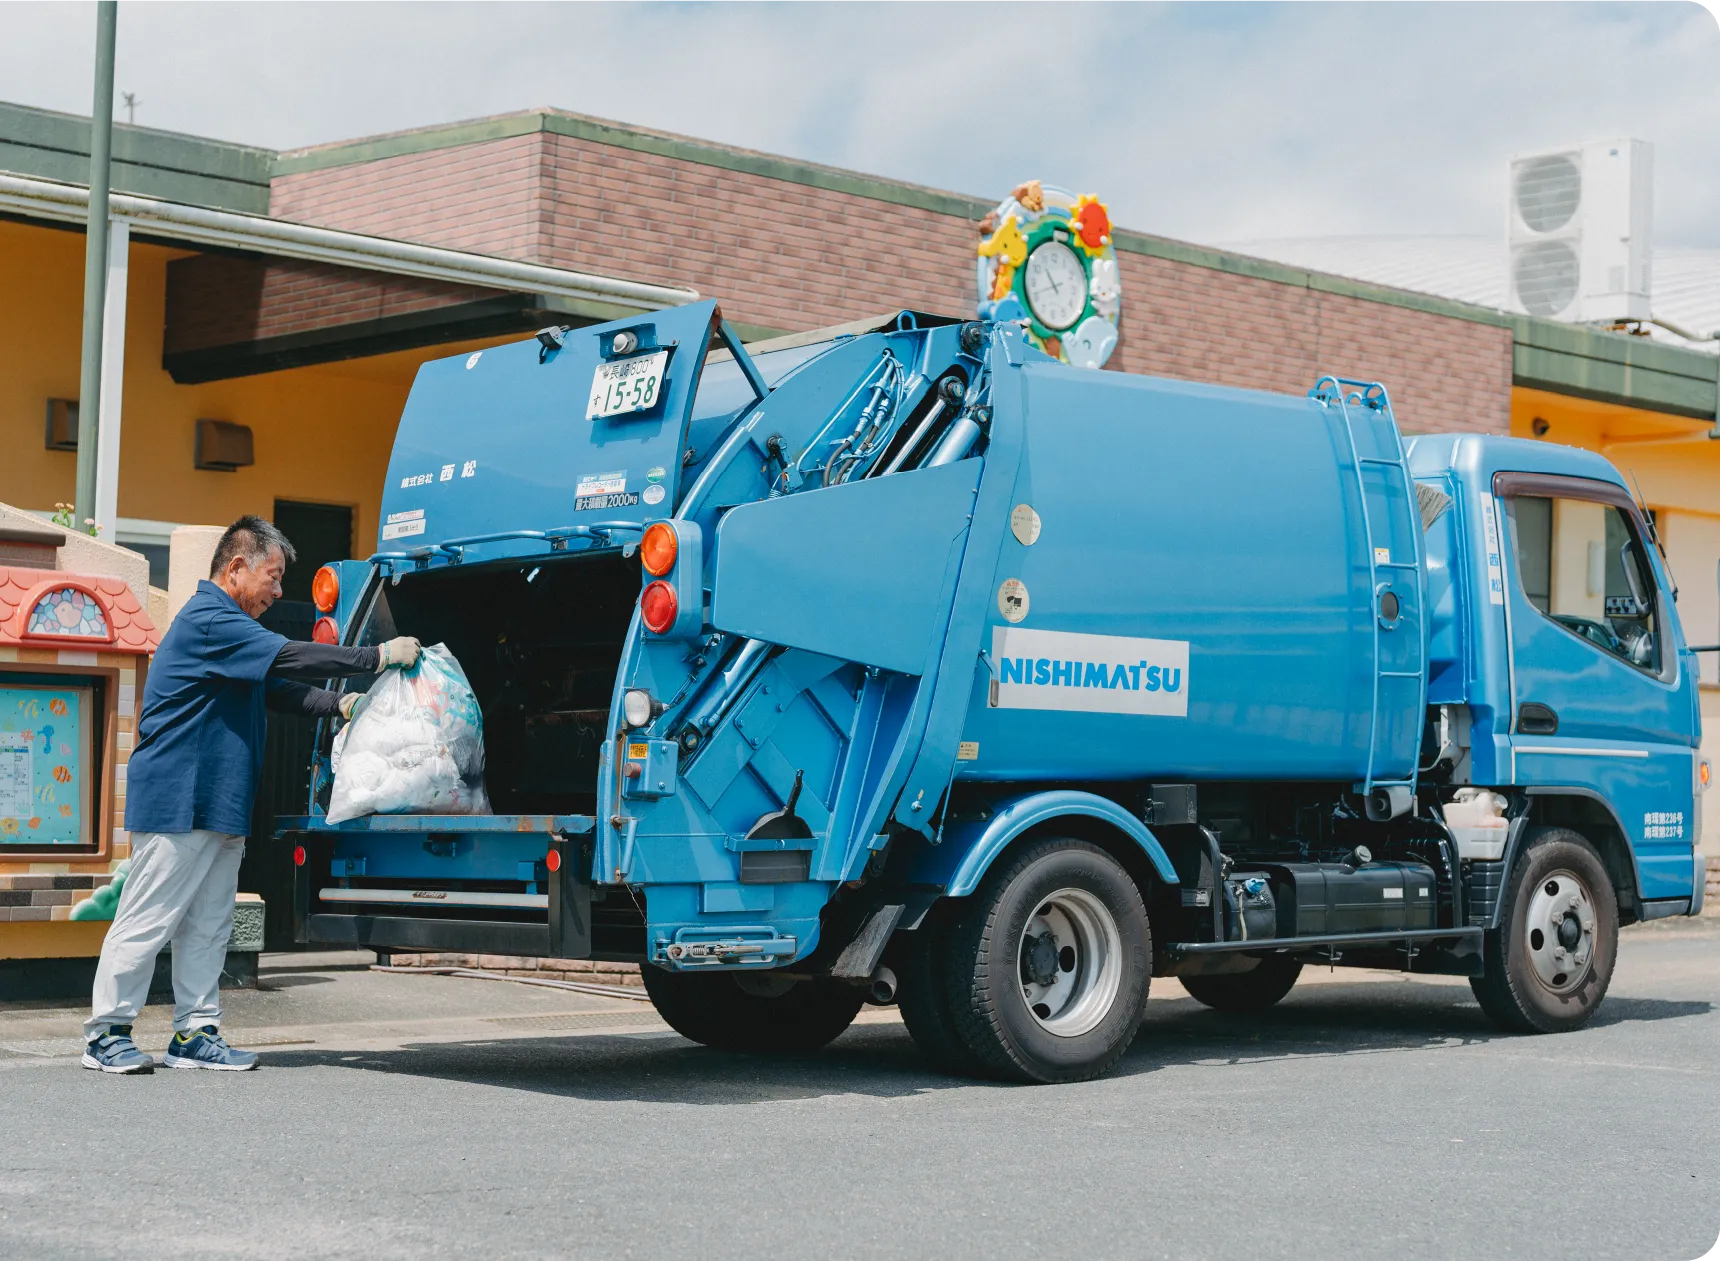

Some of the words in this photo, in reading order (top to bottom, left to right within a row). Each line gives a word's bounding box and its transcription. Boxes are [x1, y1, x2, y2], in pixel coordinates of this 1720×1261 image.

[604, 376, 656, 412] 15-58
[401, 473, 434, 489] 株式会社
[1000, 657, 1181, 692] NISHIMATSU
